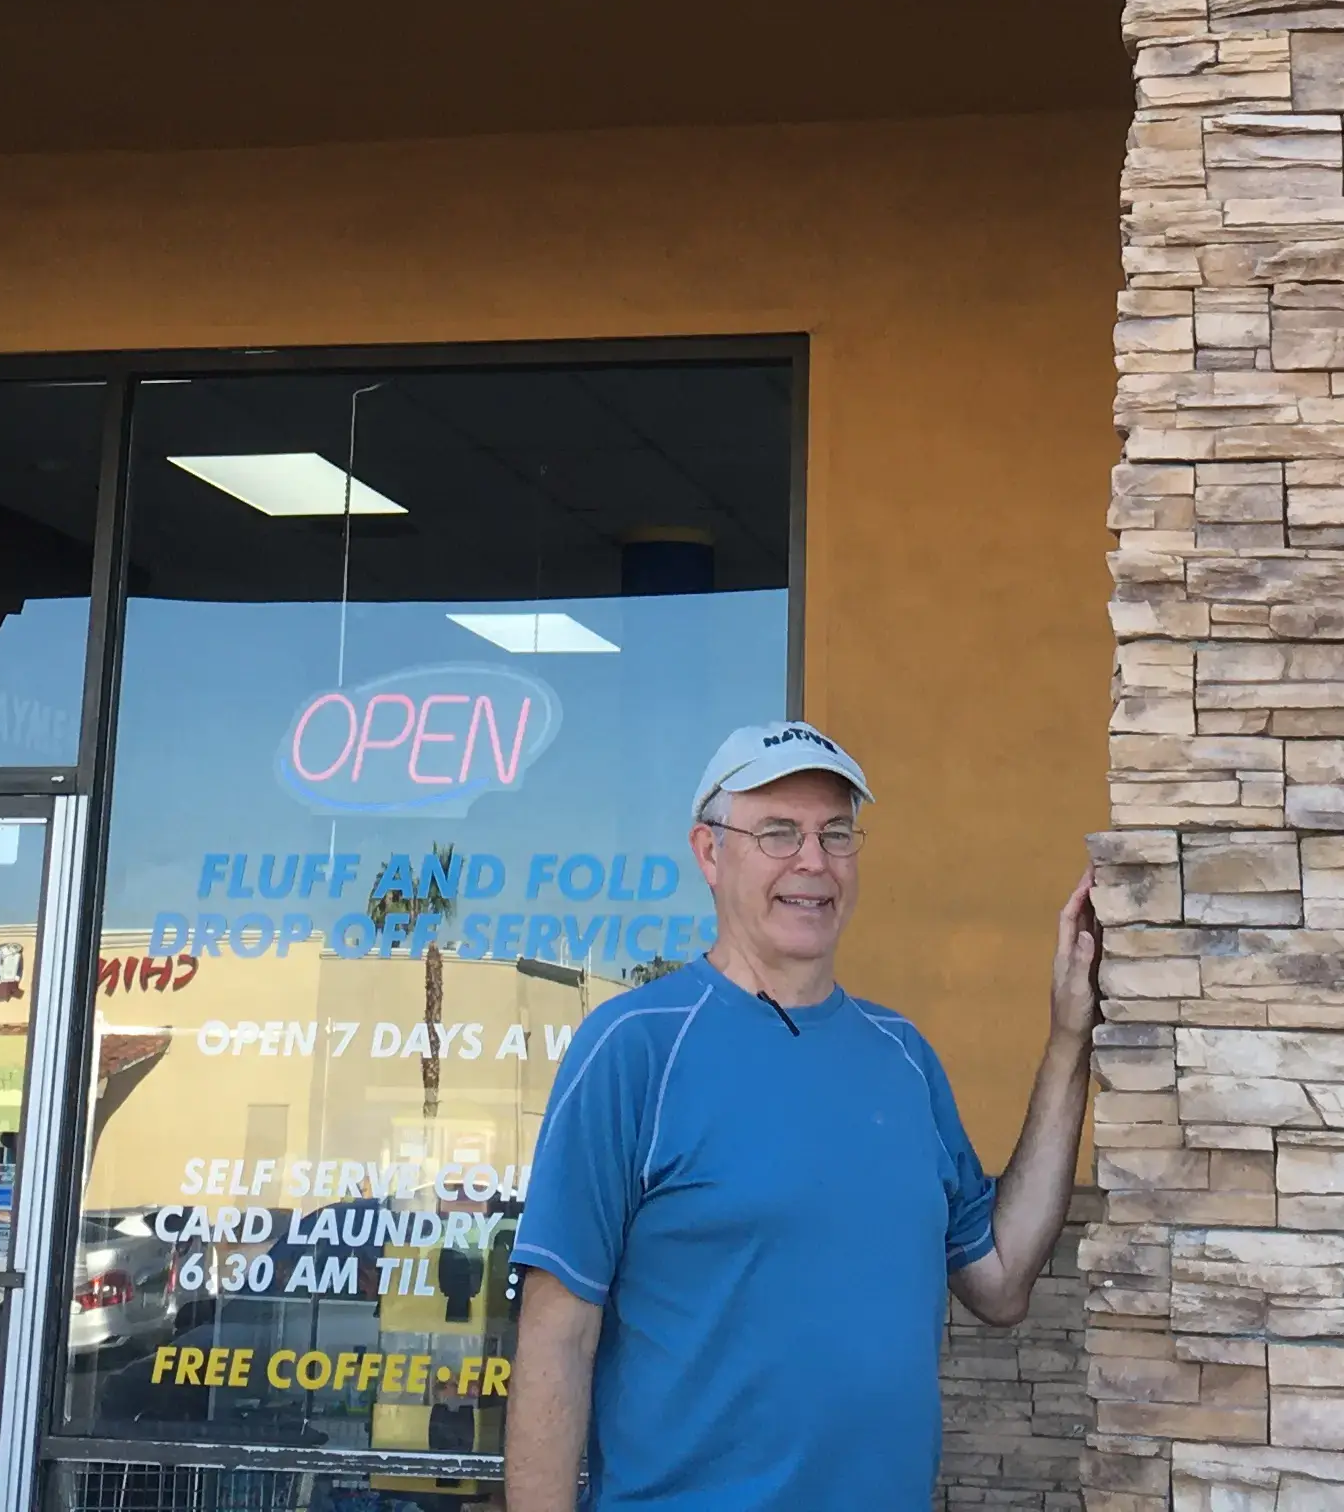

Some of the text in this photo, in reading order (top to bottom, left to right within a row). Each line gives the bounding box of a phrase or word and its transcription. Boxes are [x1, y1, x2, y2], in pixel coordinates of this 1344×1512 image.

[292, 694, 531, 785] OPEN
[197, 853, 680, 901] FLUFF AND FOLD
[147, 911, 313, 958] DROP
[332, 912, 441, 960] OFF
[197, 1020, 317, 1057] OPEN
[332, 1022, 360, 1058] 7
[370, 1022, 484, 1060] DAYS
[495, 1024, 528, 1061] A
[180, 1158, 275, 1196] SELF
[288, 1161, 420, 1199] SERVE
[155, 1205, 273, 1243] CARD
[287, 1207, 504, 1249] LAUNDRY
[179, 1253, 435, 1296] 6:30 AM TIL
[151, 1346, 254, 1387] FREE
